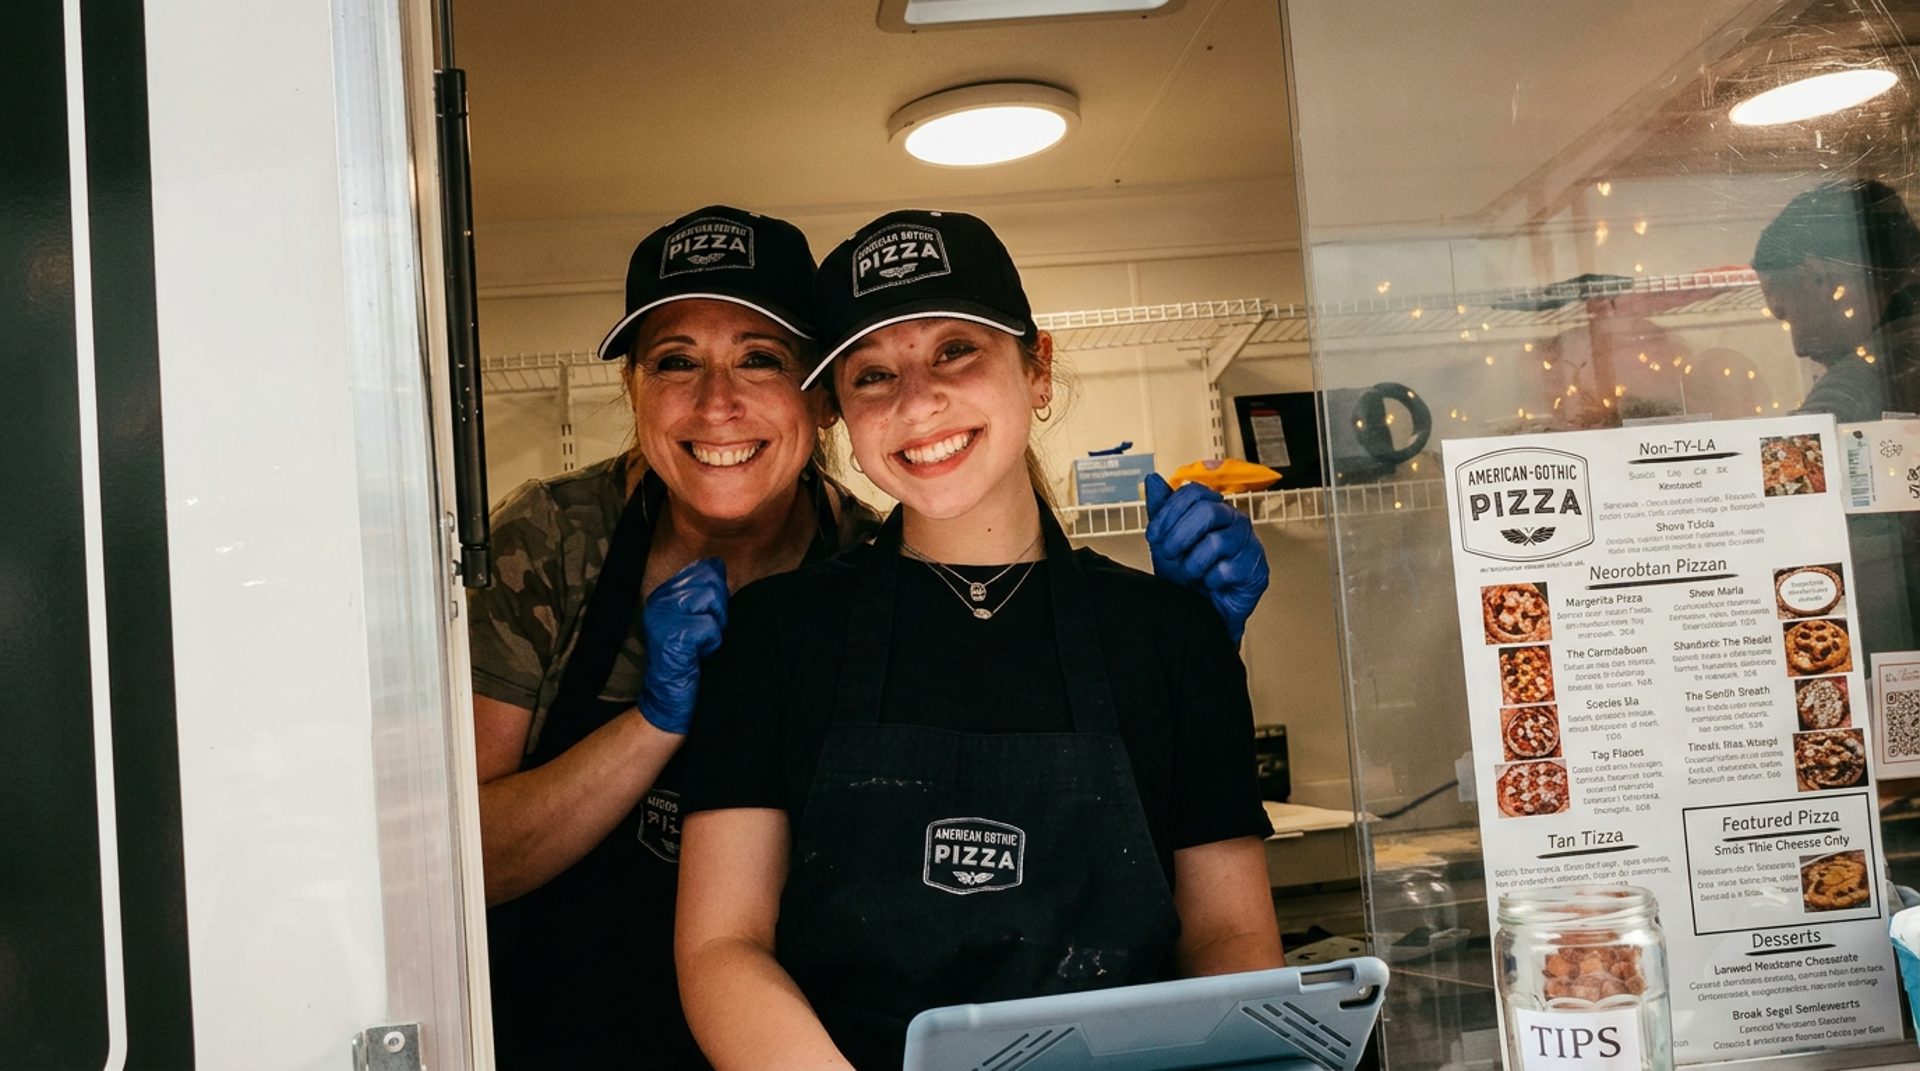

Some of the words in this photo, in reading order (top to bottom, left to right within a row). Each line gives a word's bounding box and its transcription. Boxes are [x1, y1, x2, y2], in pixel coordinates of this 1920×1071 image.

[669, 234, 746, 260] PIZZA
[859, 242, 940, 278] PIZZA
[1639, 438, 1716, 456] Non-TY-LA
[1470, 488, 1582, 521] PIZZA
[1589, 562, 1671, 581] Neorobtan
[1676, 558, 1727, 574] Pizzan
[1565, 595, 1614, 608] Margerita
[1616, 594, 1643, 603] Pizza
[1722, 638, 1741, 646] The
[1566, 650, 1585, 659] The
[1685, 692, 1703, 701] The
[1591, 751, 1610, 761] Tag
[1722, 811, 1793, 832] Featured
[1798, 809, 1840, 825] Pizza
[1547, 834, 1576, 849] Tan
[1581, 830, 1624, 846] Tizza
[934, 844, 1015, 870] PIZZA
[1752, 929, 1822, 949] Desserts
[1732, 1007, 1763, 1020] Broak
[1530, 1025, 1621, 1059] TIPS
